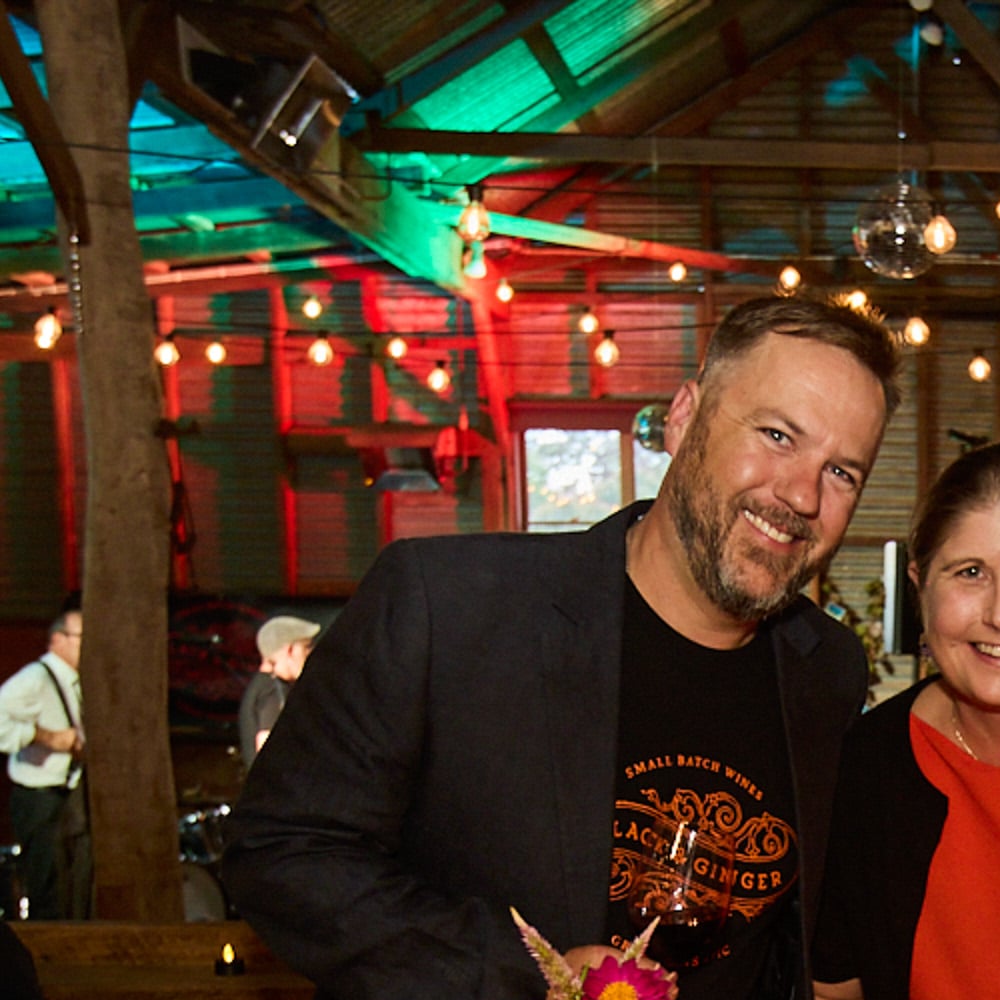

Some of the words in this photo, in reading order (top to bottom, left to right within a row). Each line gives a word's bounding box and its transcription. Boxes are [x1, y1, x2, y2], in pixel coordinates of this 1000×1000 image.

[624, 754, 673, 779] SMALL
[677, 754, 721, 773] BATCH
[724, 765, 765, 802] WINES
[612, 819, 668, 854] LACK
[693, 856, 783, 892] GINGER
